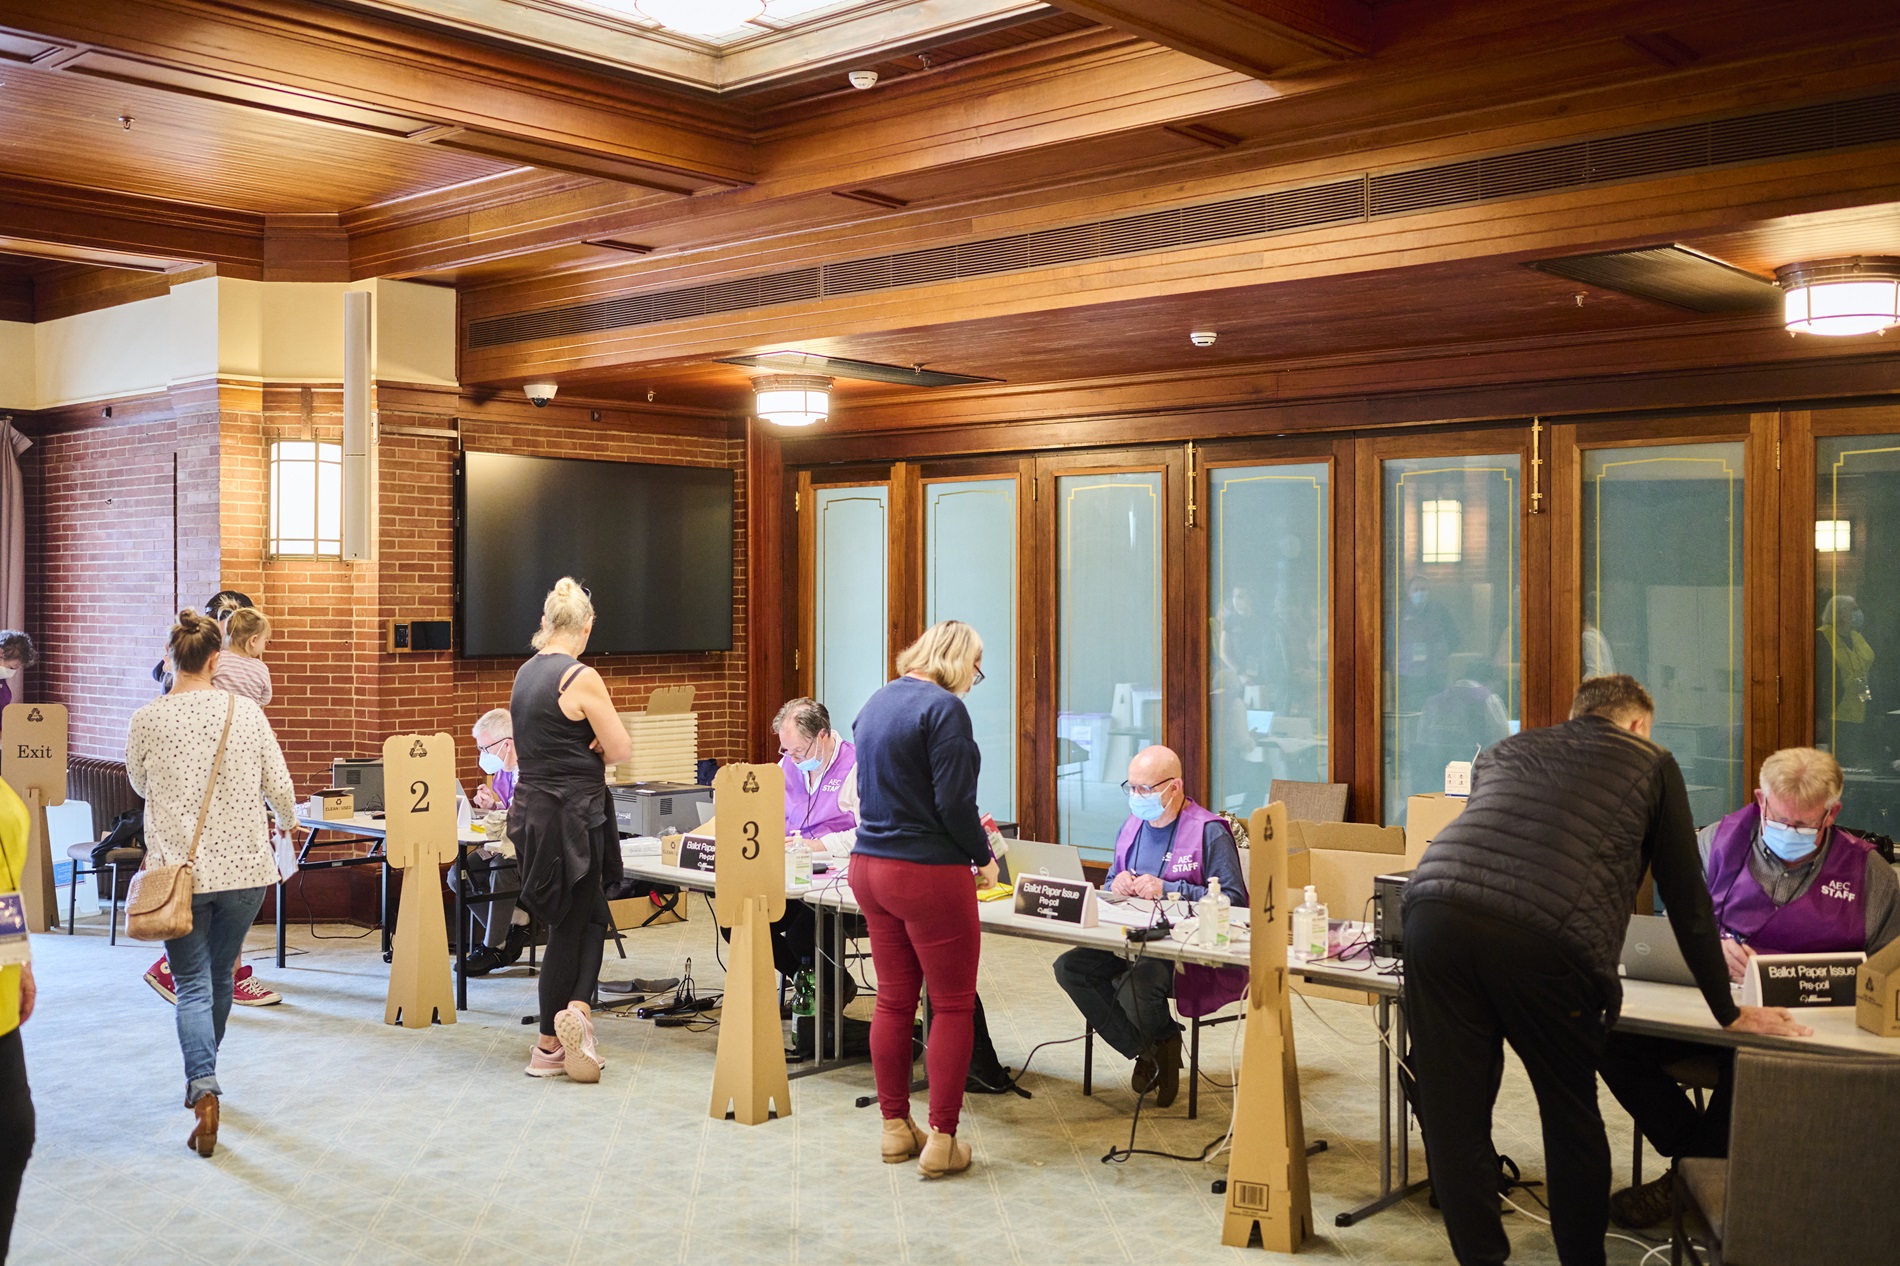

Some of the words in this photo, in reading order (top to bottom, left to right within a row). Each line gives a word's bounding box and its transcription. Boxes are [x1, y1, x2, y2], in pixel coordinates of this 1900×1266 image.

[17, 744, 53, 759] Exit
[410, 780, 430, 813] 2
[686, 840, 701, 850] Ballot
[701, 842, 715, 853] Pape
[741, 820, 760, 860] 3
[1177, 854, 1193, 864] AEC
[1172, 861, 1199, 873] STAFF
[1023, 882, 1041, 894] Ballot
[1041, 884, 1062, 897] Paper
[1061, 888, 1080, 899] Issue
[1829, 879, 1851, 891] AEC
[1263, 875, 1275, 923] 4
[1821, 885, 1856, 902] STAFF
[1039, 896, 1060, 907] Pre-poll
[1768, 965, 1796, 978] Ballot
[1798, 965, 1828, 979] Paper
[1829, 965, 1856, 976] Issue
[1799, 980, 1830, 991] Pre-poll
